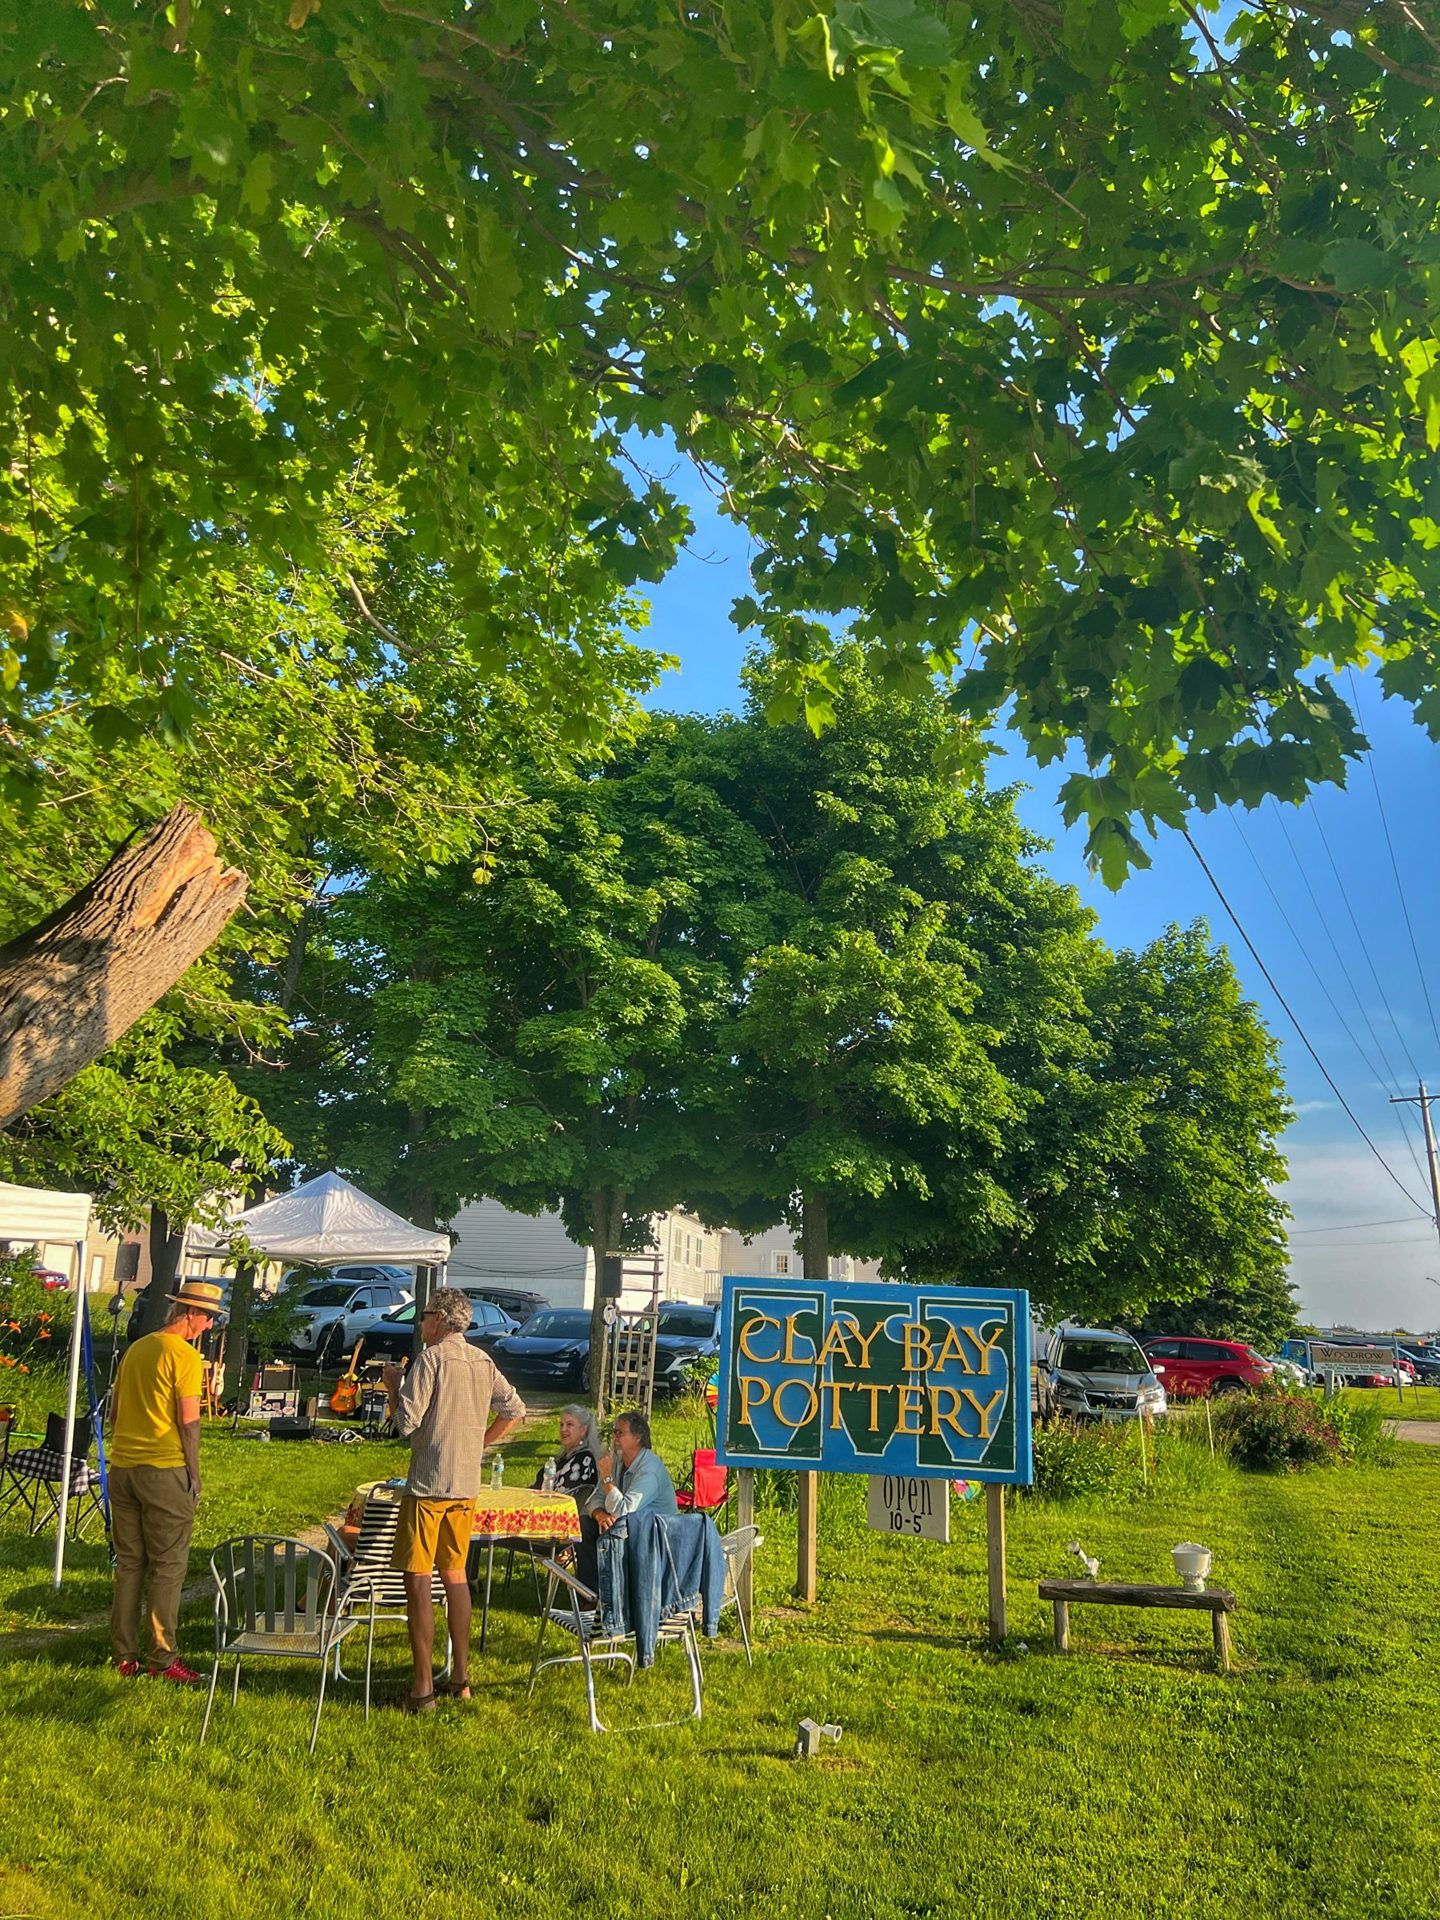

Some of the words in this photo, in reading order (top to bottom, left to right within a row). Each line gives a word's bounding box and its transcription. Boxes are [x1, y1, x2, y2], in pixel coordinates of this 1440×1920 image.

[739, 1316, 885, 1369] CLAY
[901, 1323, 1005, 1376] BAY
[737, 1376, 1004, 1439] POTTERY
[889, 1511, 923, 1534] 10-5
